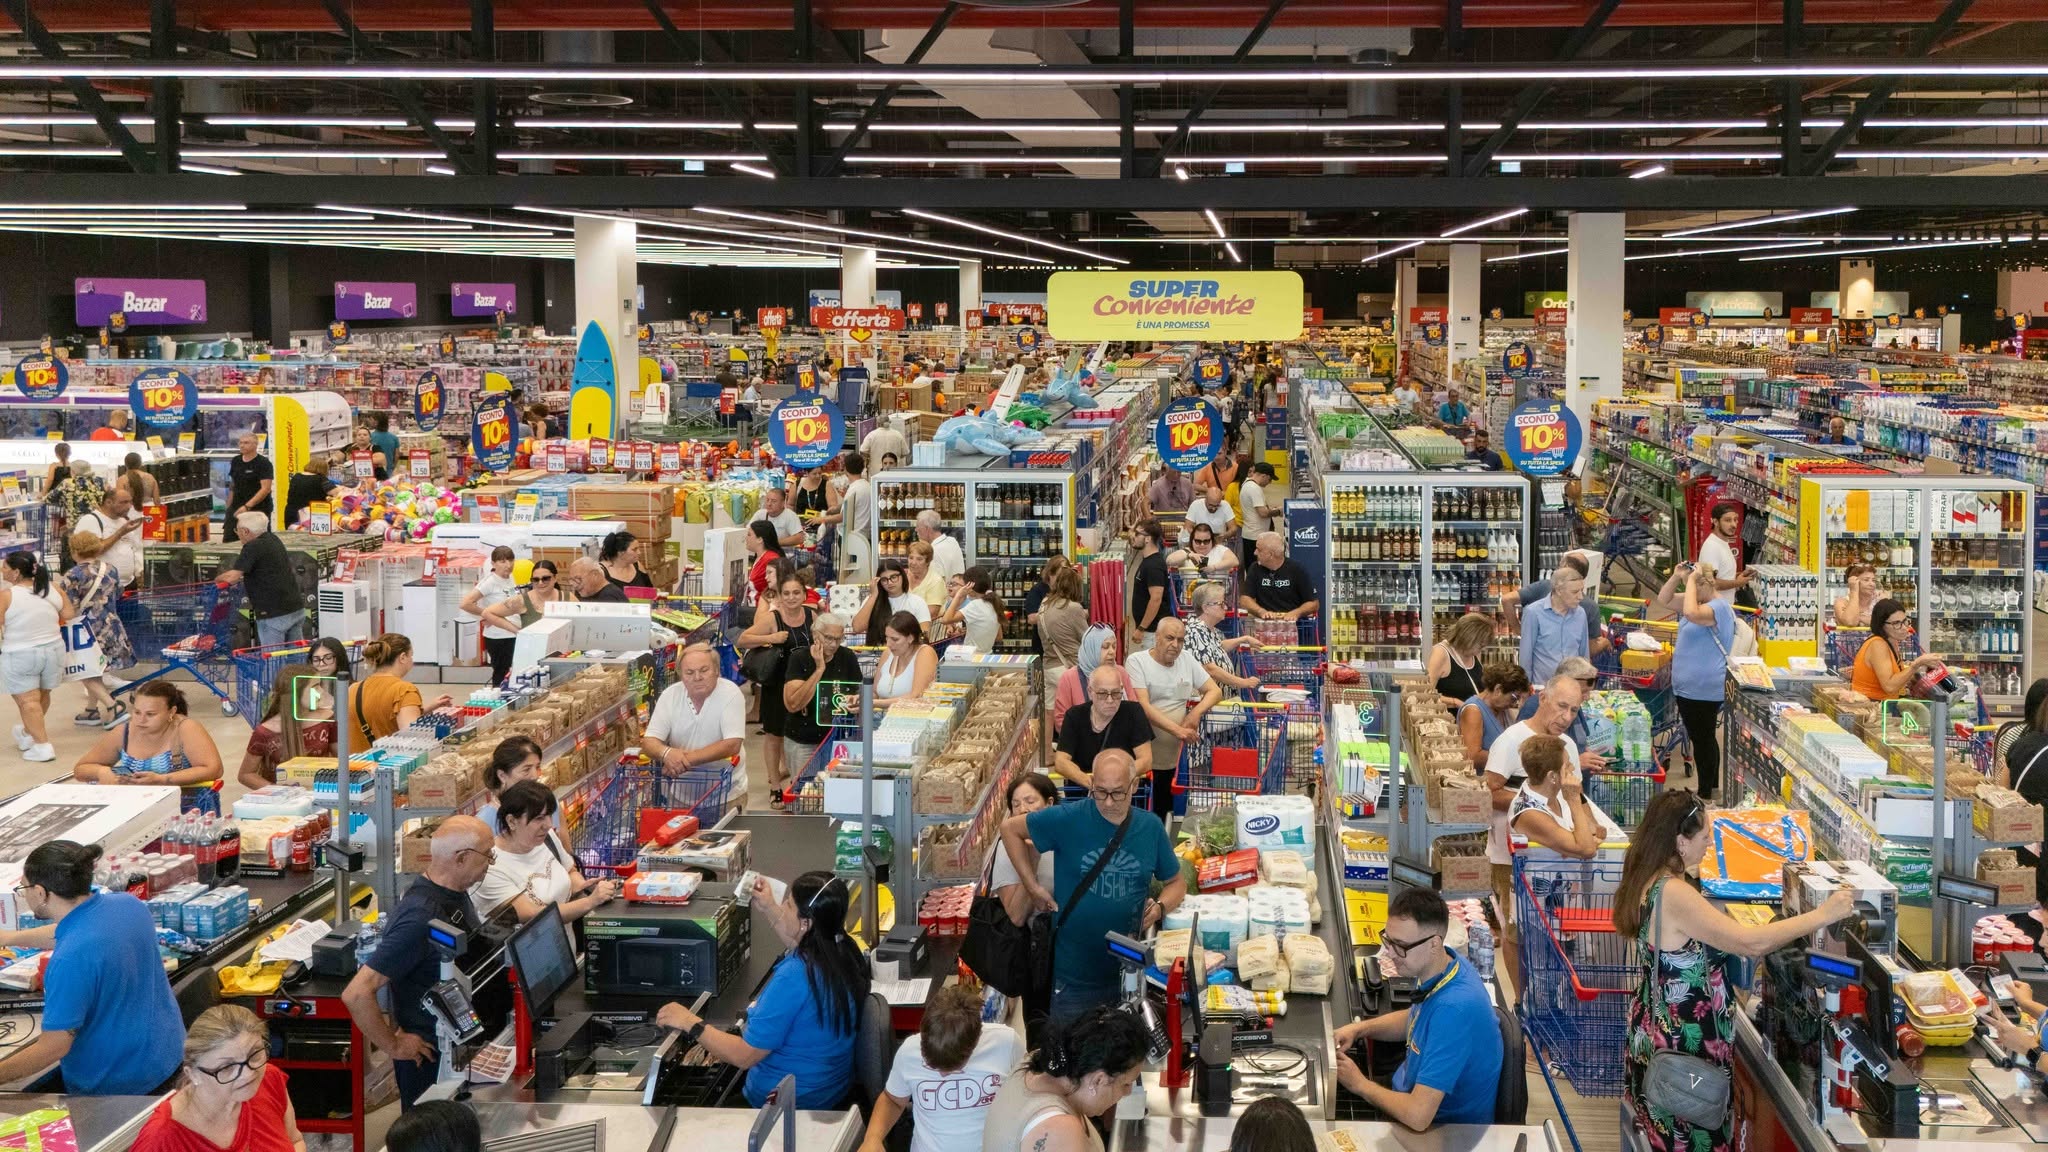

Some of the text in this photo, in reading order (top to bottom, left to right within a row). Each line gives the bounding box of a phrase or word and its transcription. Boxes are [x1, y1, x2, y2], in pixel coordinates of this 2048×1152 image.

[1129, 280, 1219, 298] SUPER
[123, 292, 167, 312] Bazar
[364, 292, 392, 310] Bazar
[474, 293, 496, 308] Bazar
[1093, 294, 1256, 316] Conveniente
[832, 311, 890, 328] offerta
[1136, 319, 1211, 329] È UNA PROMESSA
[23, 362, 50, 370] SCONTO
[26, 369, 57, 386] 10%
[140, 379, 174, 389] SCONTO
[145, 388, 183, 408] 10%
[479, 409, 503, 423] SCONTO
[780, 408, 818, 418] SCONTO
[1167, 411, 1201, 423] SCONTO
[1517, 414, 1555, 425] SCONTO
[482, 421, 508, 447] 10%
[786, 418, 828, 443] 10%
[1171, 422, 1209, 448] 10%
[1522, 425, 1564, 450] 10%
[591, 456, 606, 464] 24.90
[636, 460, 651, 468] 19.90
[662, 461, 678, 469] 24.90
[358, 468, 371, 476] 5.90
[415, 467, 428, 476] 3.50
[311, 522, 330, 532] 24.90
[440, 567, 462, 575] AKAI
[1246, 818, 1272, 829] NICKY
[1689, 1073, 1703, 1090] V
